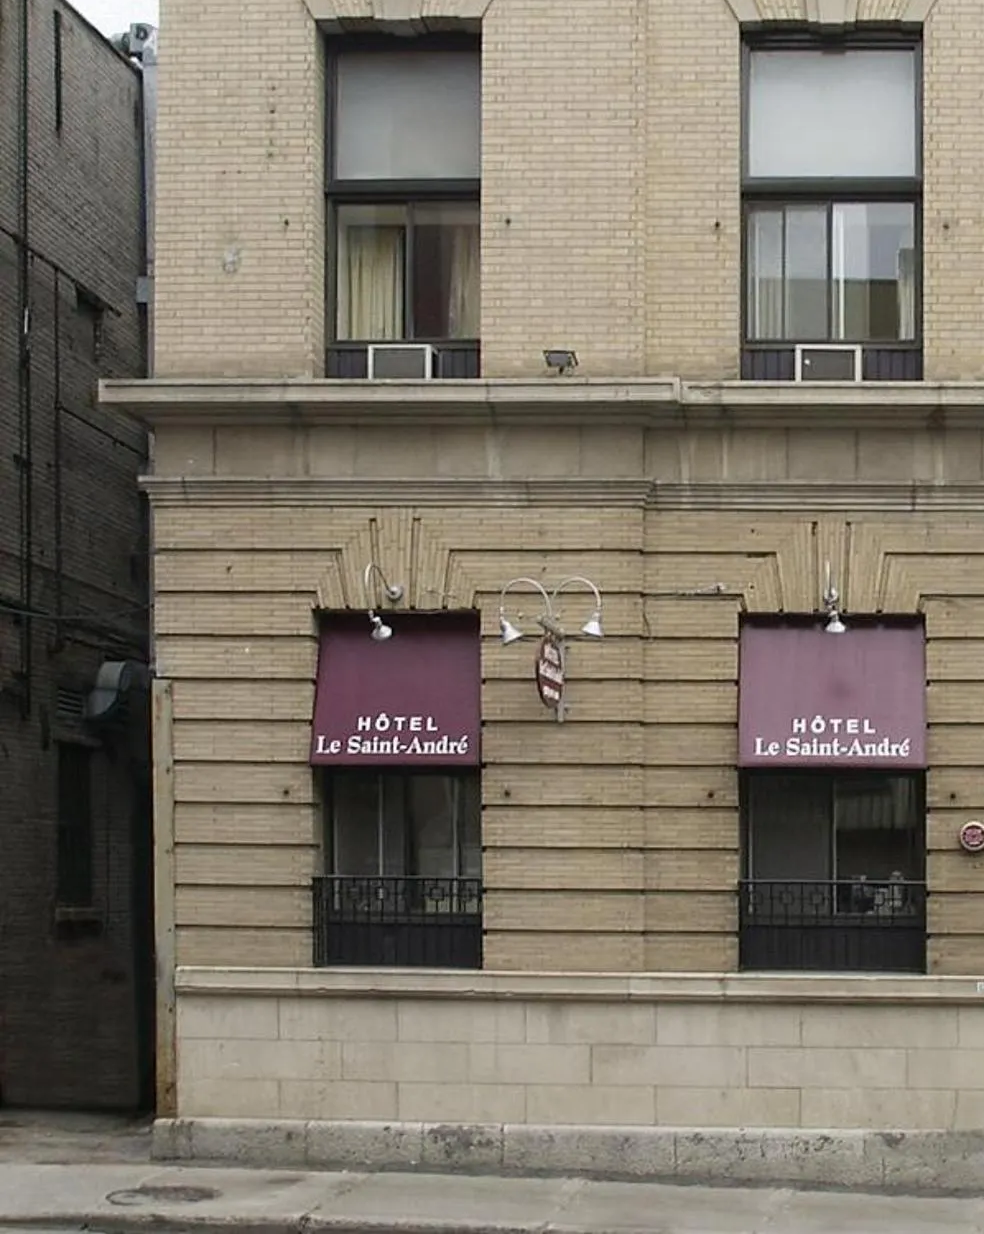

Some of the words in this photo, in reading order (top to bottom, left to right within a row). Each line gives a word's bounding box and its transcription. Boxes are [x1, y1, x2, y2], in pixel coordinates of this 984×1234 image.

[357, 713, 438, 732] HÔTEL
[792, 715, 876, 734] HÔTEL
[315, 735, 341, 754] Le
[347, 735, 469, 754] Saint-André
[754, 737, 781, 756] Le
[786, 737, 911, 756] Saint-André
